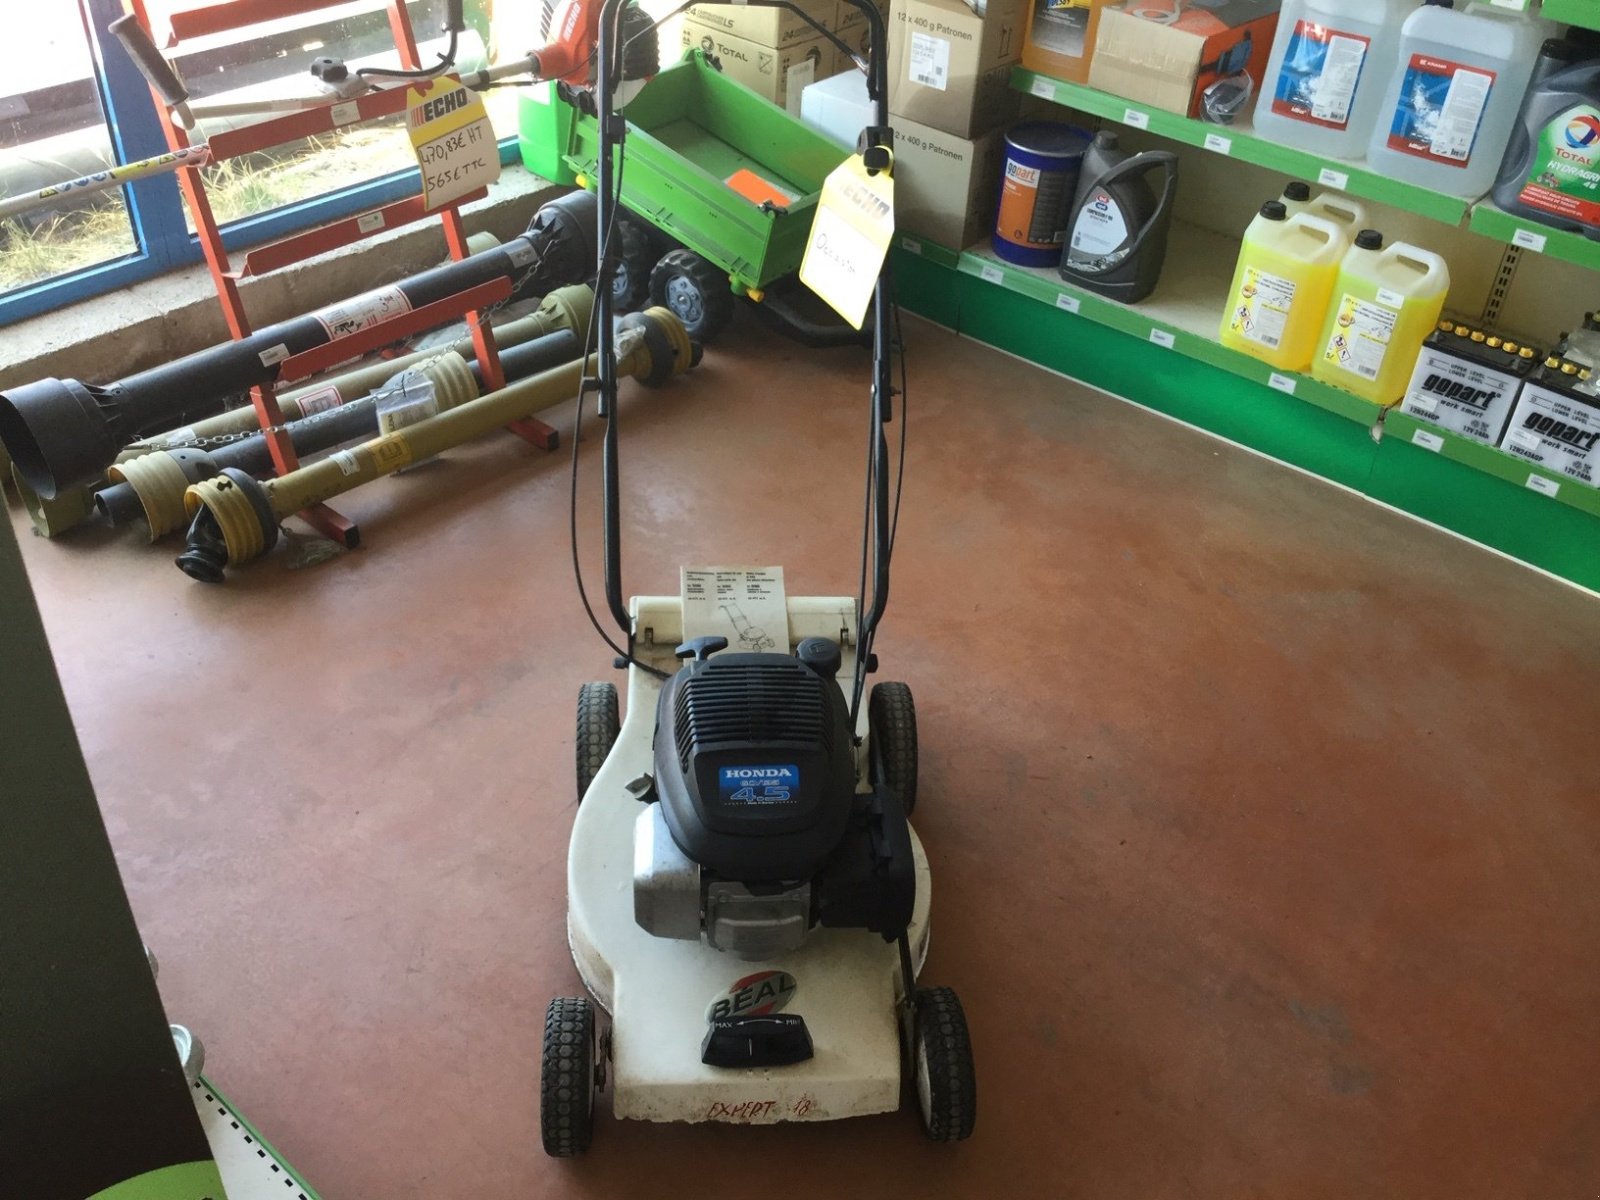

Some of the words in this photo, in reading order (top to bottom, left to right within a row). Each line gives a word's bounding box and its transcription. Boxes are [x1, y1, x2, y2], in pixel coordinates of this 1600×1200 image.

[897, 12, 906, 22] 12
[907, 15, 913, 23] x
[914, 17, 928, 28] 400
[929, 22, 935, 31] g
[936, 23, 973, 41] Patronen
[717, 43, 749, 62] TOTAL
[423, 87, 468, 123] ECHO
[420, 132, 466, 165] 470,83€
[466, 125, 483, 145] HT
[907, 136, 920, 147] 400
[921, 142, 928, 151] g
[928, 143, 964, 161] Patronen
[1555, 146, 1593, 167] TOTAL
[427, 166, 461, 192] 565€
[462, 157, 487, 174] TTC
[1007, 162, 1037, 182] gopart
[1448, 368, 1466, 378] LOWER
[1468, 376, 1483, 384] LEVEL
[1450, 363, 1468, 373] UPPER
[1470, 370, 1486, 379] LEVEL
[1421, 373, 1496, 409] gopart
[1440, 400, 1459, 409] work
[1461, 407, 1484, 418] smart
[1551, 407, 1570, 417] LOWER
[1571, 415, 1588, 425] LEVEL
[1554, 401, 1572, 412] UPPER
[1574, 409, 1590, 419] LEVEL
[1522, 412, 1600, 450] gopart
[1541, 439, 1561, 450] work
[1562, 447, 1587, 459] smart
[725, 768, 792, 779] HONDA
[730, 785, 791, 802] 4.5
[715, 1021, 733, 1029] MAX
